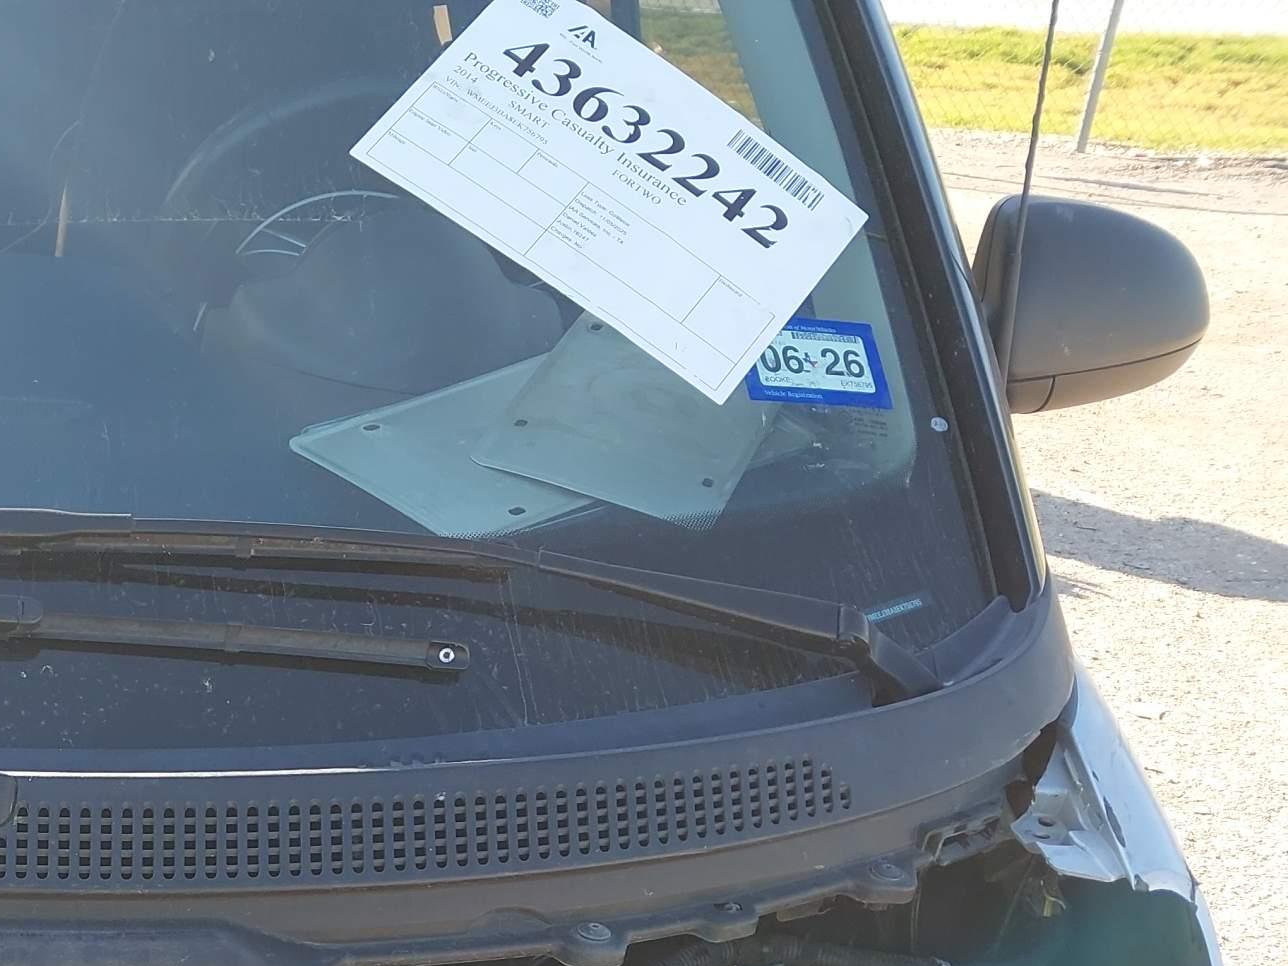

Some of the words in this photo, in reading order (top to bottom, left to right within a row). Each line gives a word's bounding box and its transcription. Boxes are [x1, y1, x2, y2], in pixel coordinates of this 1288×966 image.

[453, 65, 479, 83] 2014
[510, 100, 550, 129] SMART
[611, 168, 662, 205] FORTWO
[464, 52, 549, 111] Progressive
[552, 109, 616, 155] Casualty
[616, 151, 687, 207] Insurance
[502, 43, 789, 249] 43632242
[761, 345, 805, 374] 06
[821, 348, 865, 378] 26
